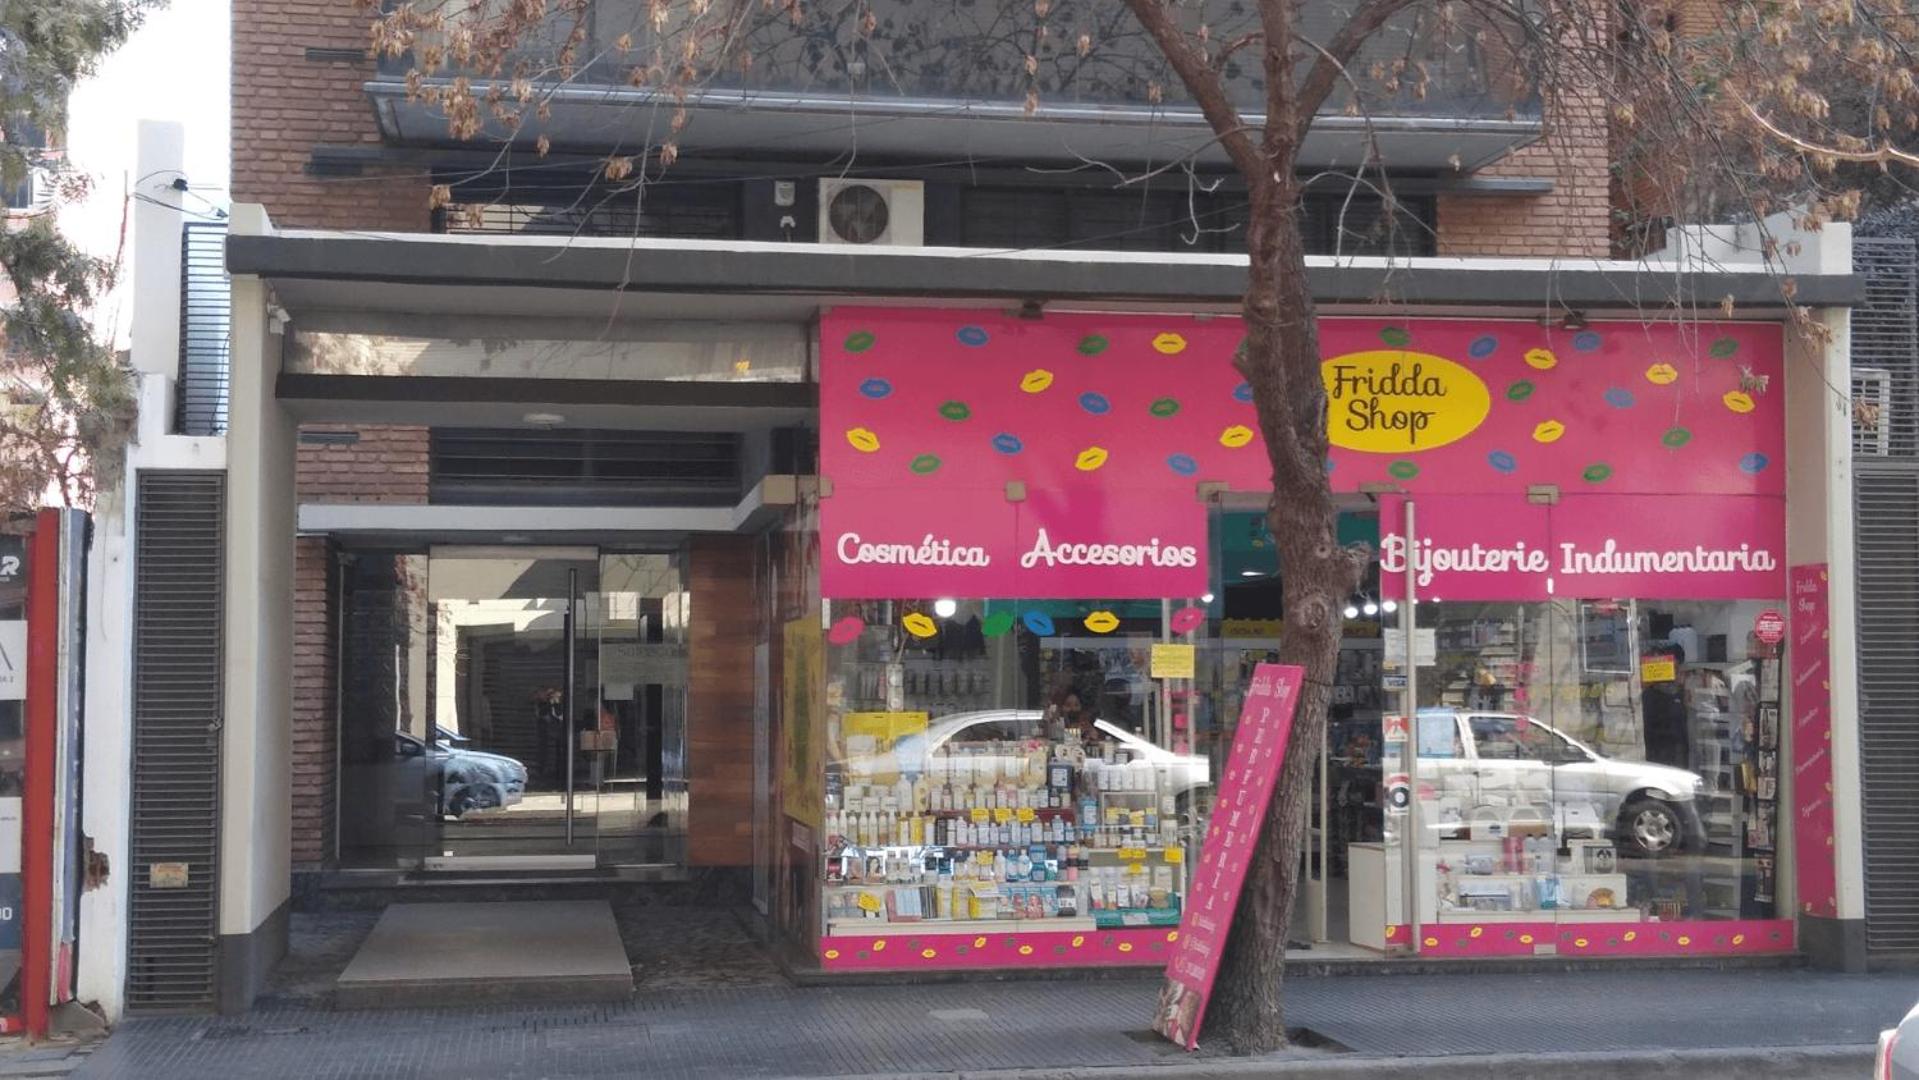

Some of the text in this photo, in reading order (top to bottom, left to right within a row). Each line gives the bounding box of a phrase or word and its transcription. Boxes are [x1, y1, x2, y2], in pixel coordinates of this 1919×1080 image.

[1333, 363, 1447, 399] Fridda
[1346, 397, 1436, 445] Shop
[837, 527, 1776, 586] Cosmética Accesorios Bijouterie Indumentaria
